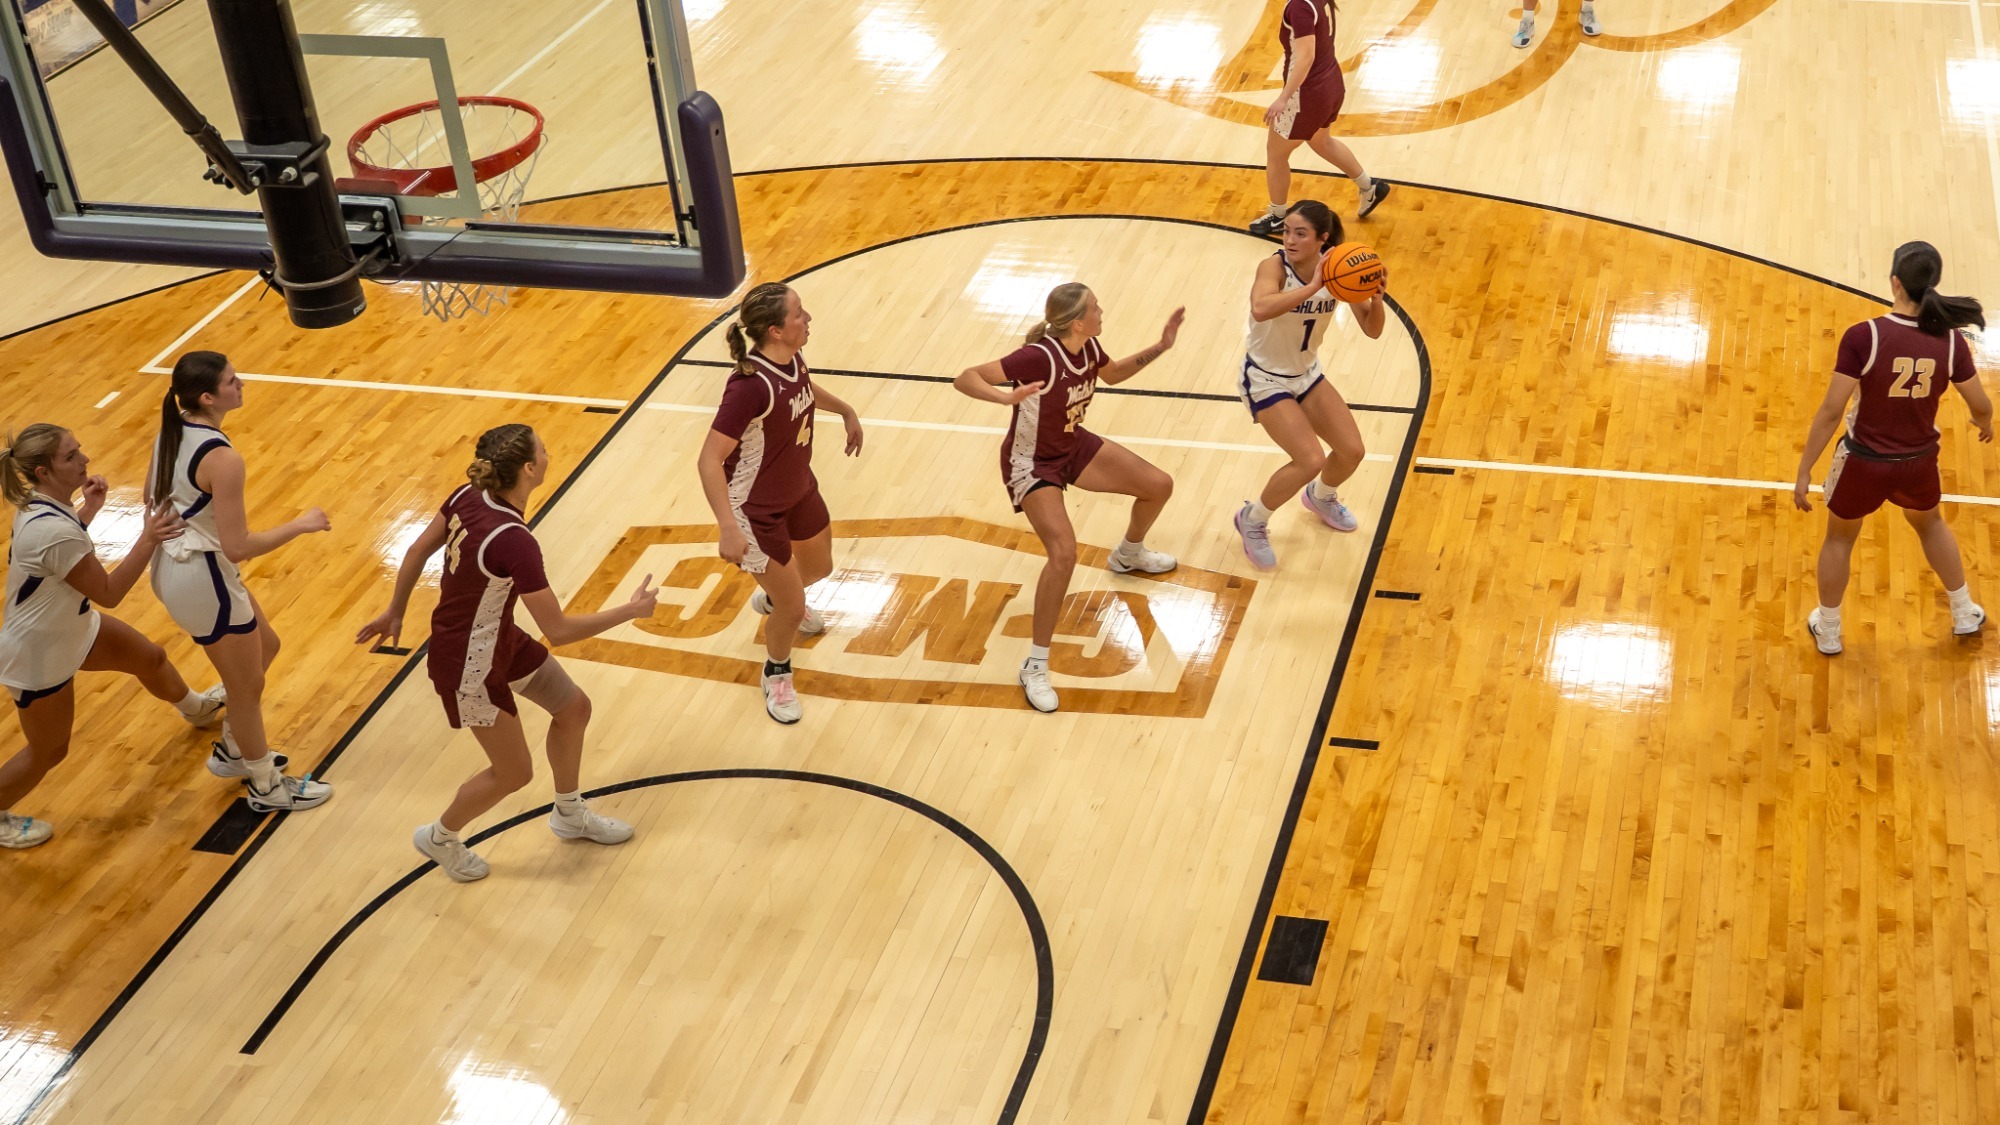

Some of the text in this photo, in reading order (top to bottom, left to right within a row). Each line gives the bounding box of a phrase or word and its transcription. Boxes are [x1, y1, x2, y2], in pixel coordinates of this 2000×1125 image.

[1346, 252, 1380, 267] Wilson
[1300, 318, 1317, 352] 1
[1888, 356, 1936, 399] 23
[789, 382, 815, 422] Walsh
[795, 413, 811, 447] 4
